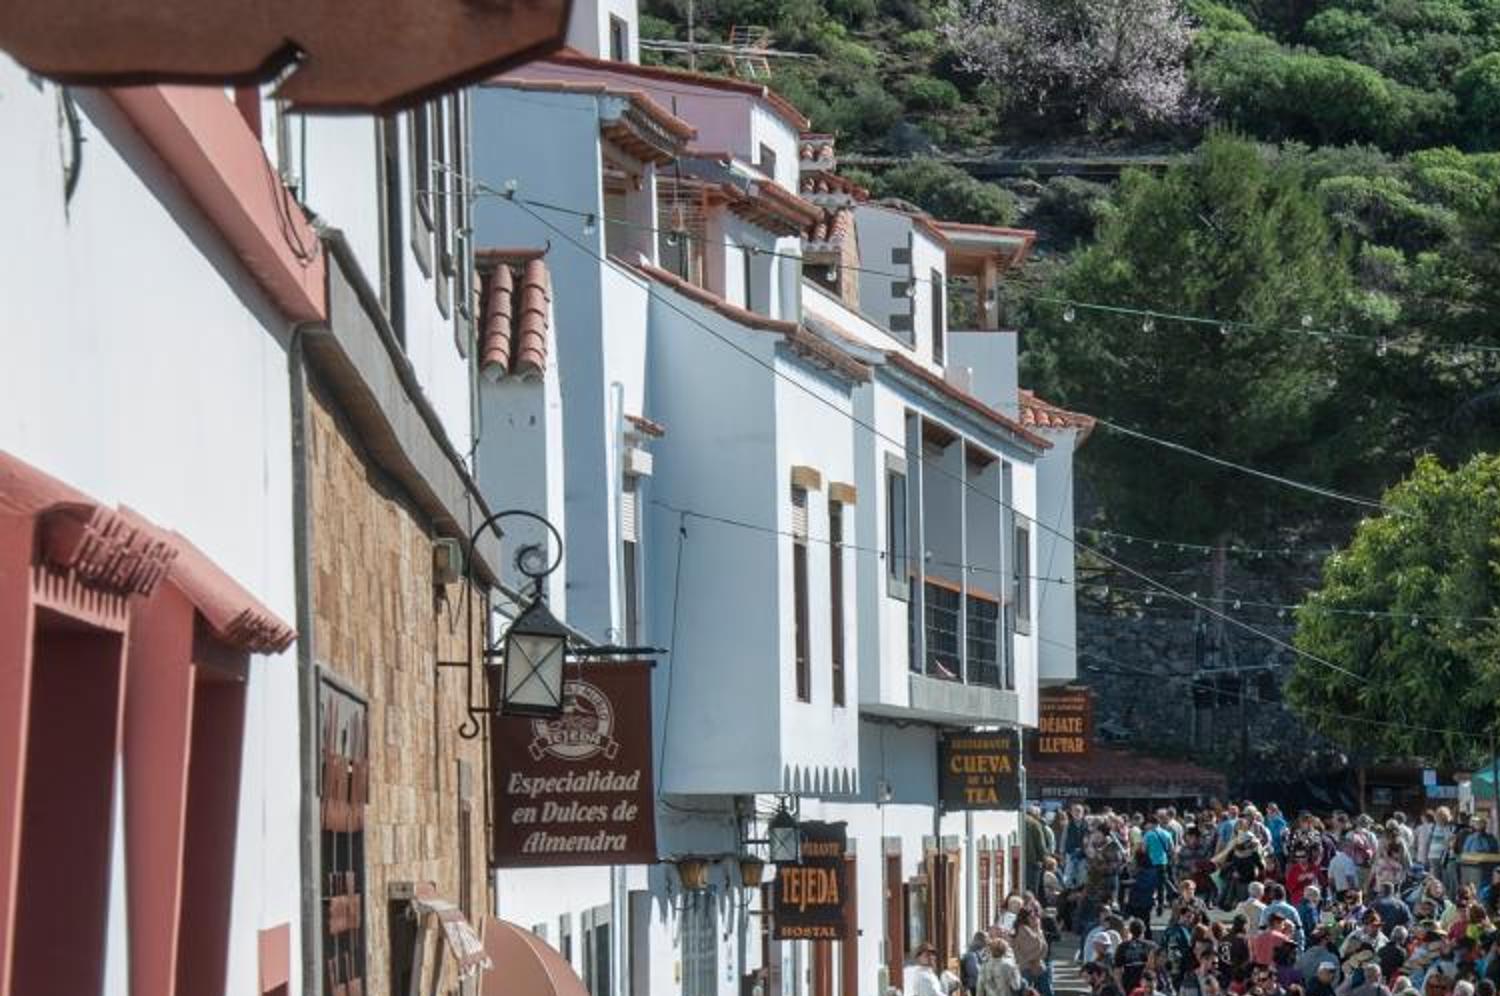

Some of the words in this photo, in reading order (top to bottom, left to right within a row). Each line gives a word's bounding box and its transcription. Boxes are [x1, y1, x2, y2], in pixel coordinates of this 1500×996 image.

[1039, 737, 1084, 753] LLEVAR
[951, 755, 1012, 774] CUEVA
[508, 769, 640, 798] Especialidad
[965, 787, 998, 804] TEA
[512, 806, 536, 824] en
[541, 801, 608, 824] Dulces
[612, 800, 638, 822] de
[522, 830, 628, 853] Almendra
[782, 866, 839, 913] TEJEDA
[781, 927, 837, 938] HOSTAL
